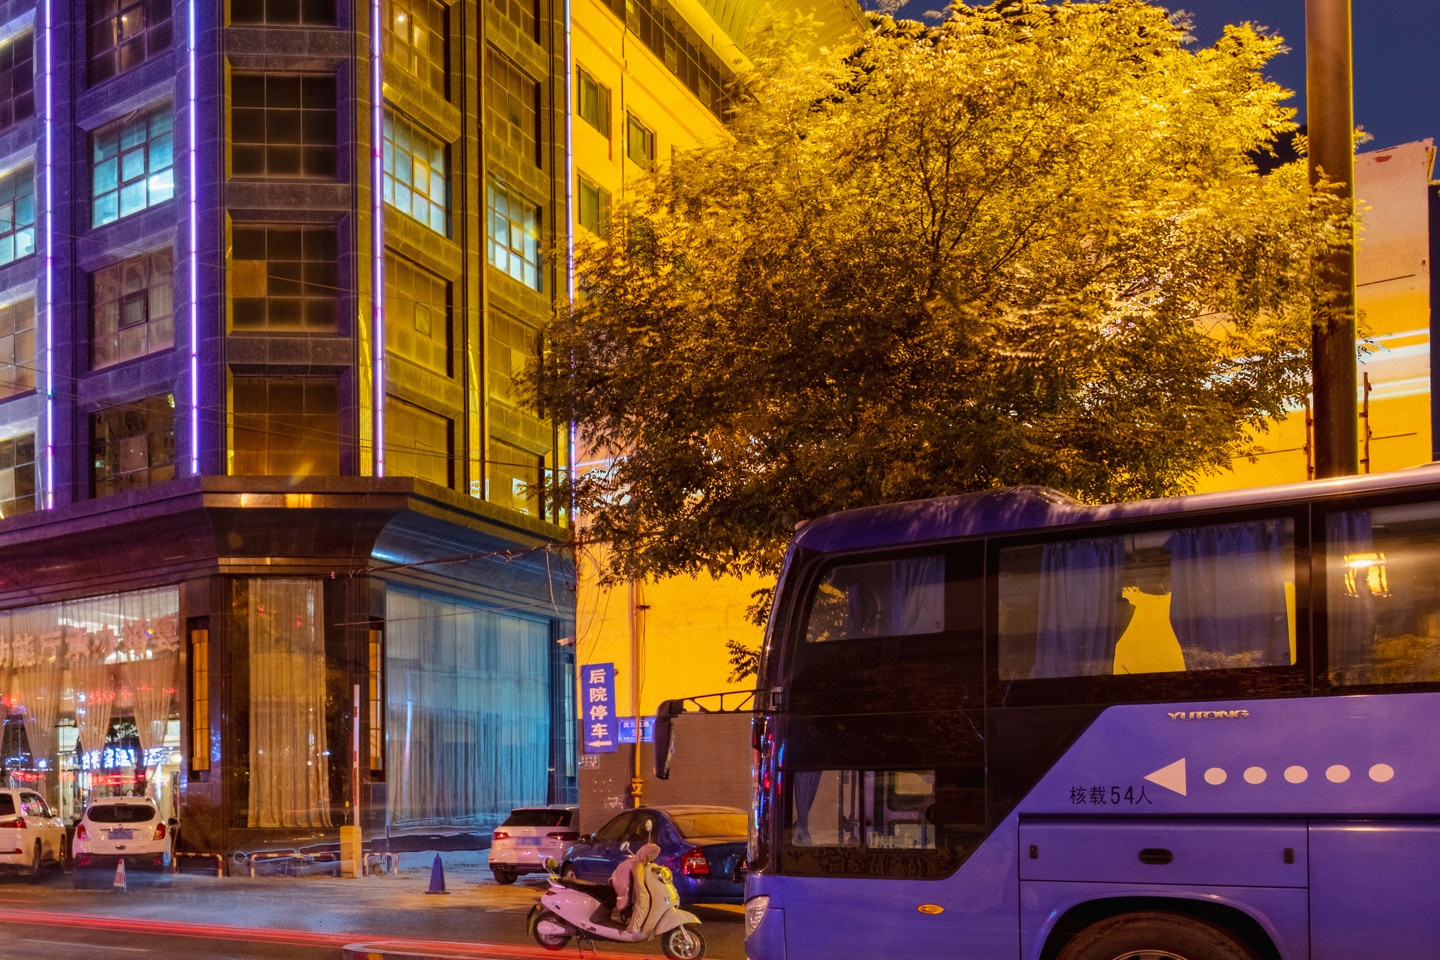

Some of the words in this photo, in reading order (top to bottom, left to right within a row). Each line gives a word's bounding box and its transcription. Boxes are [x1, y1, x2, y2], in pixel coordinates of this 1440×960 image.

[589, 668, 608, 738] 后院停车
[1167, 709, 1250, 721] YUTONG
[1070, 786, 1153, 805] 核载54人
